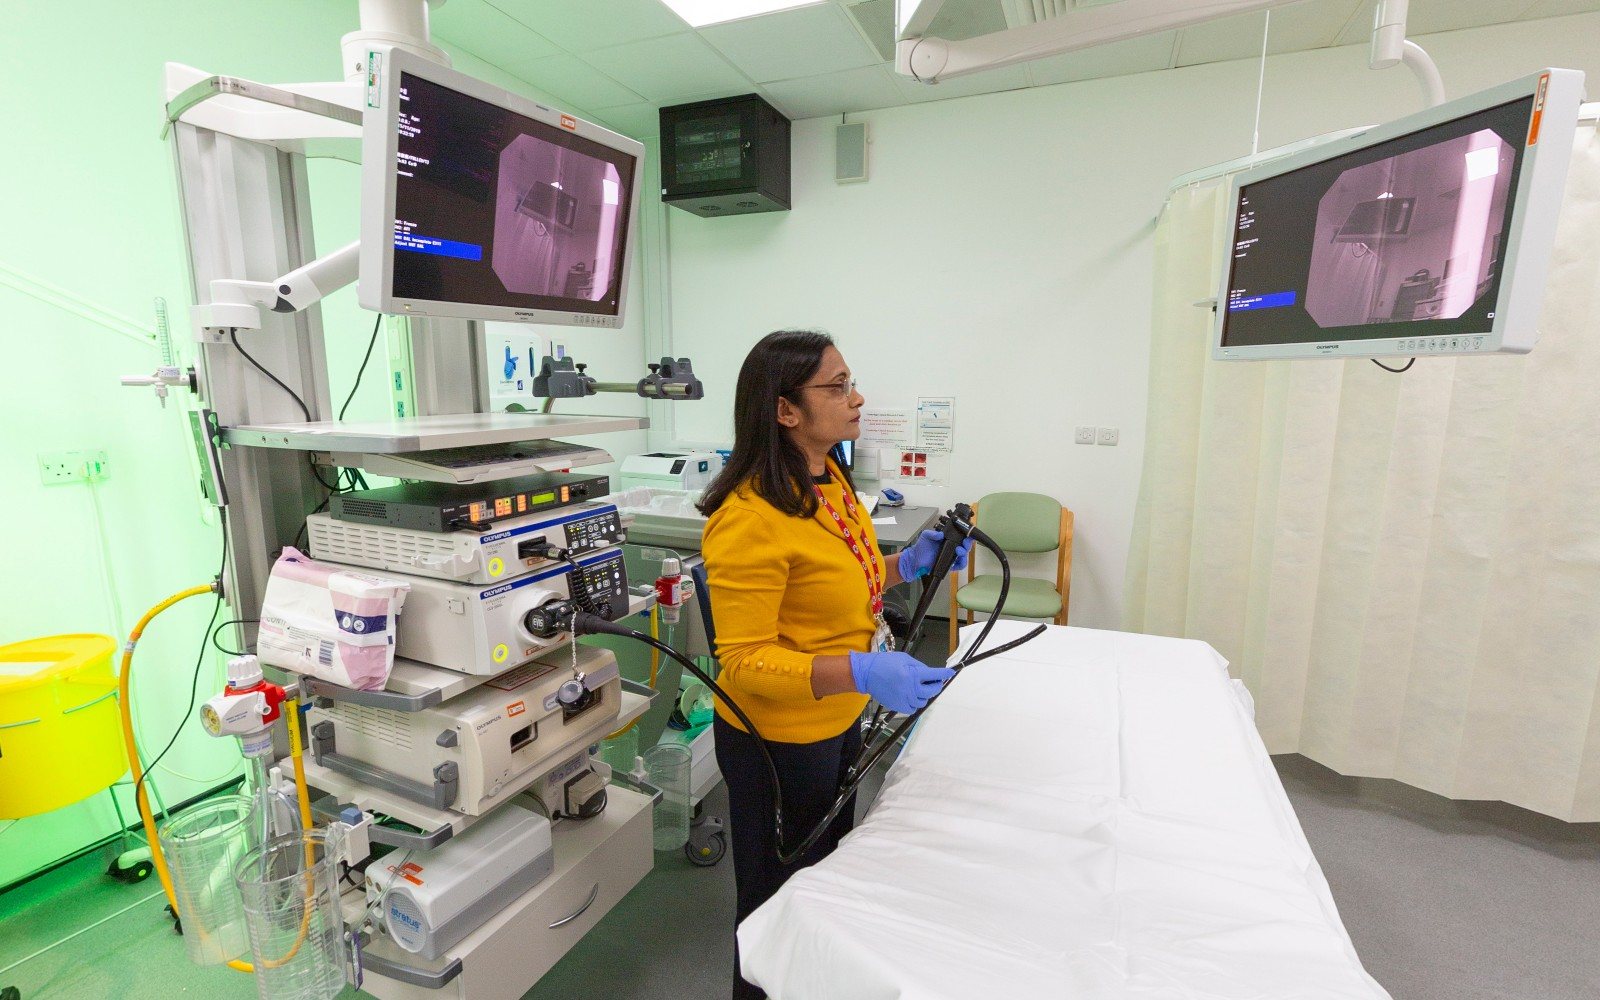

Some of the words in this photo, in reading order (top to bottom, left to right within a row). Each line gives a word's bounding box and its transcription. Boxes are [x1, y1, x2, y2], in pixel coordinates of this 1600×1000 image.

[484, 530, 511, 543] OLYMPUS
[484, 584, 513, 598] OLYMPUS
[476, 715, 502, 730] OLYMPUS
